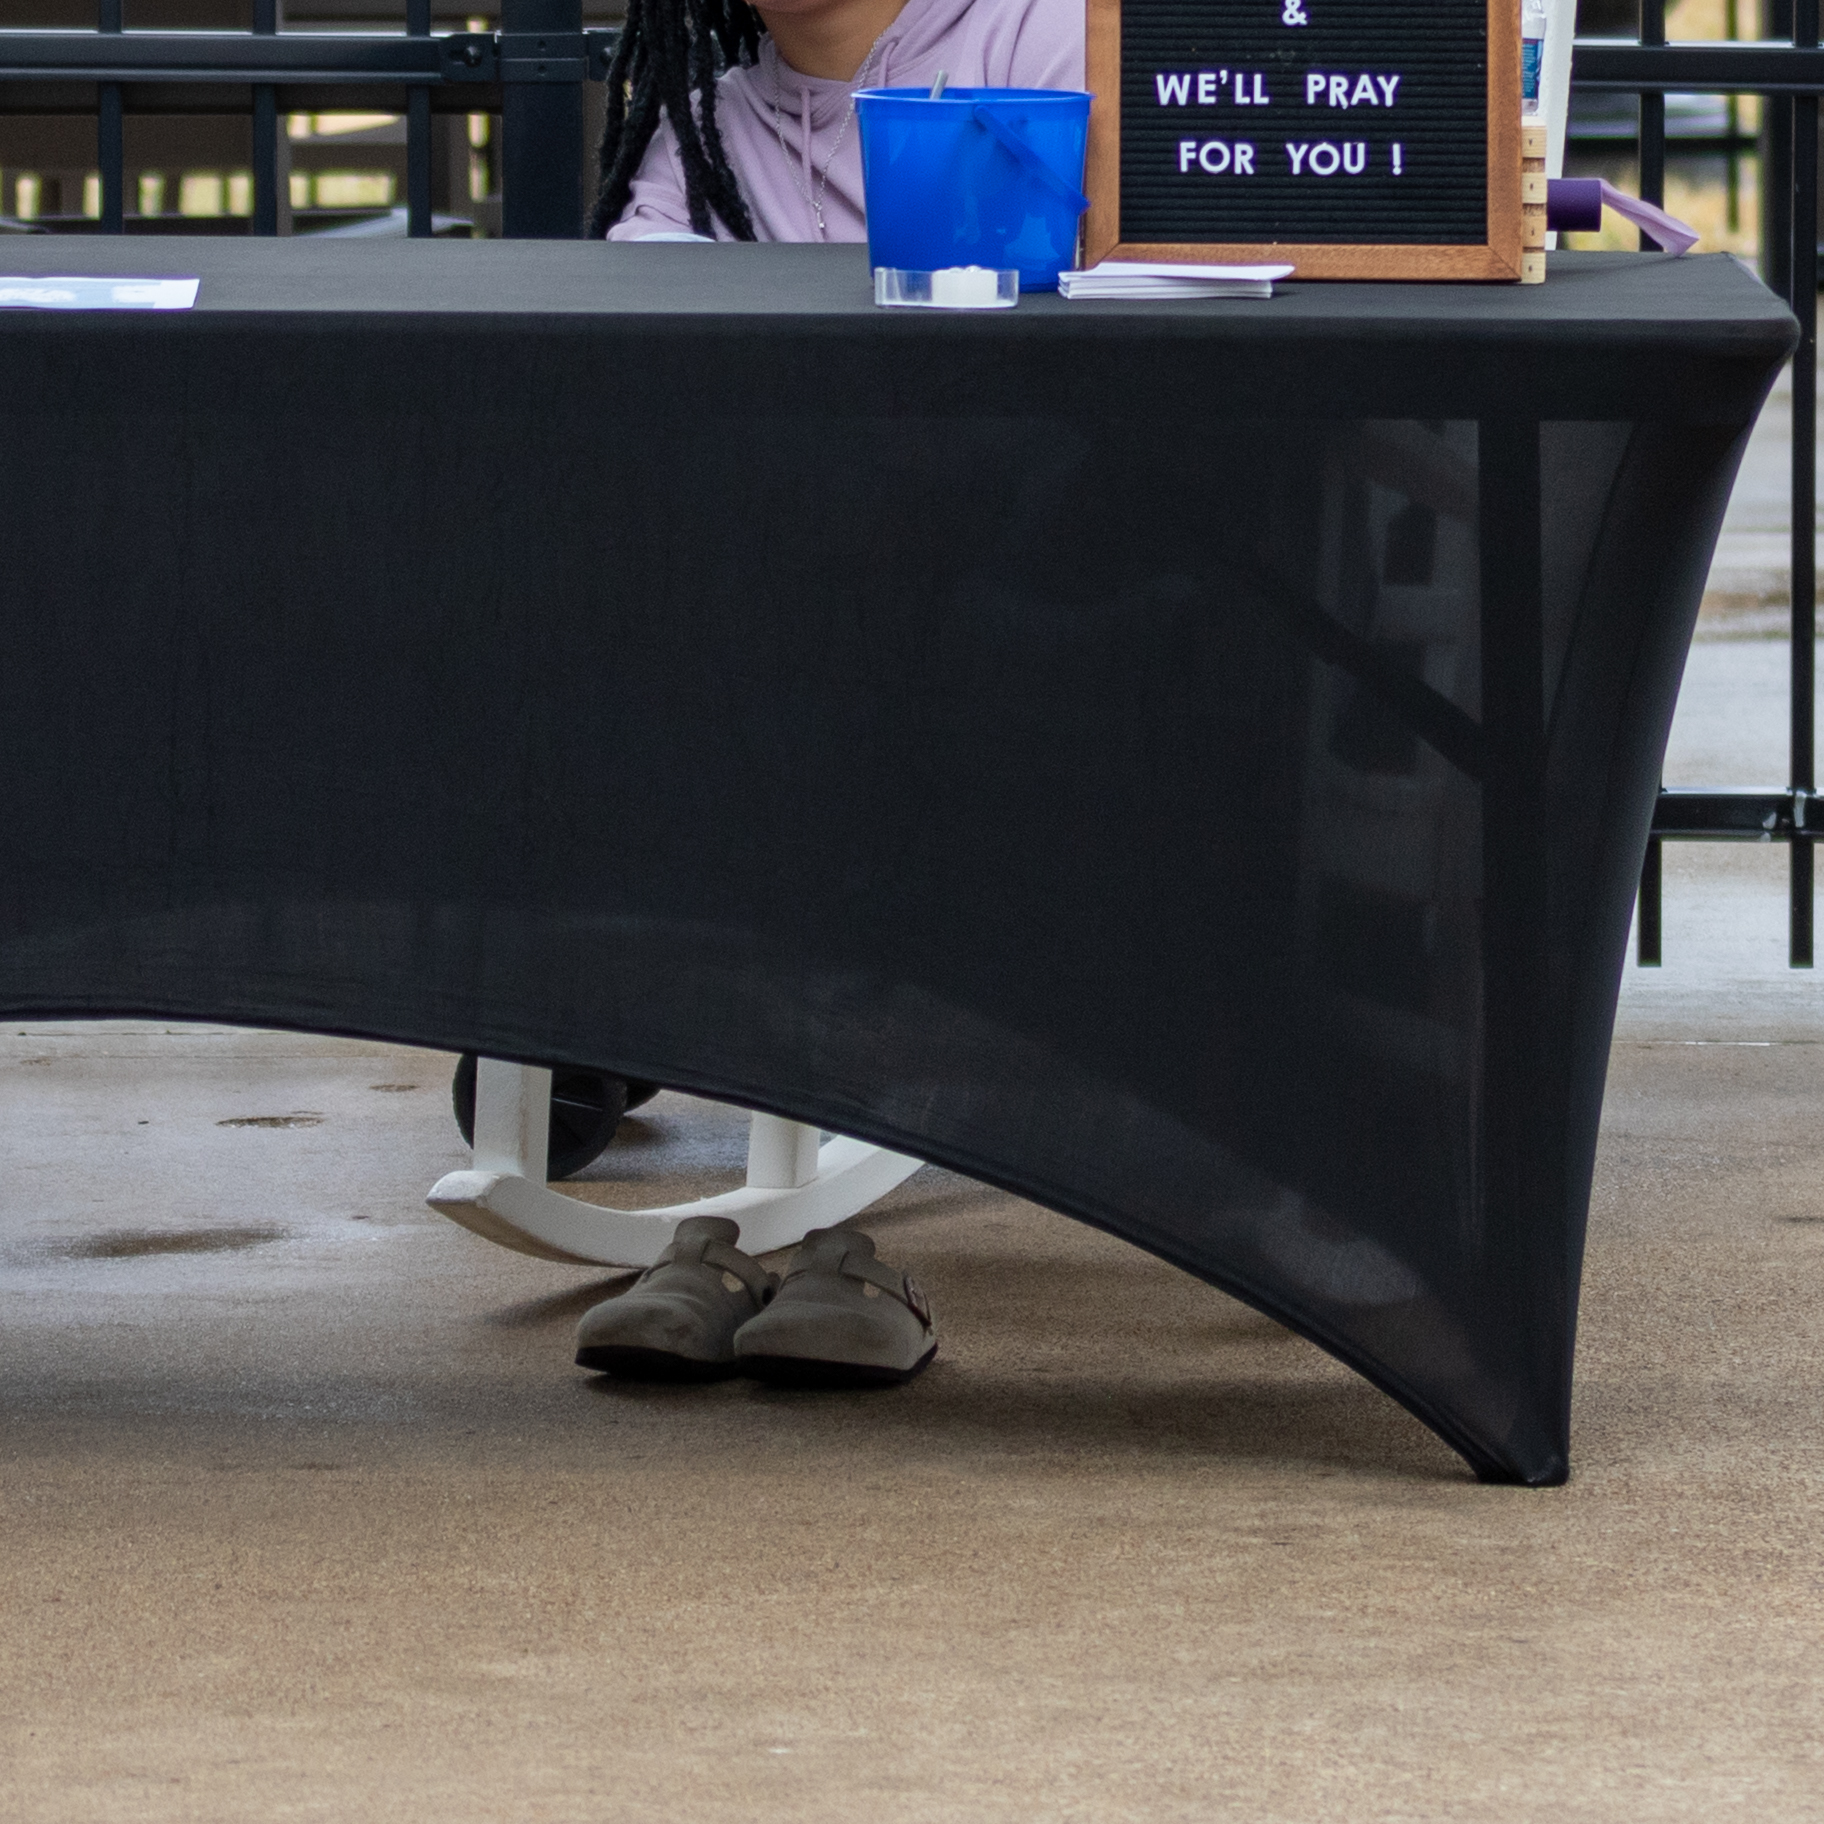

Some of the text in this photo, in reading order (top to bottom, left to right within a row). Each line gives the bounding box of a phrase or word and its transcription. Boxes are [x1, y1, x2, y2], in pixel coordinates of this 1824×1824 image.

[1156, 69, 1400, 108] WE'LL PRAY
[1179, 141, 1403, 175] FOR YOU !
